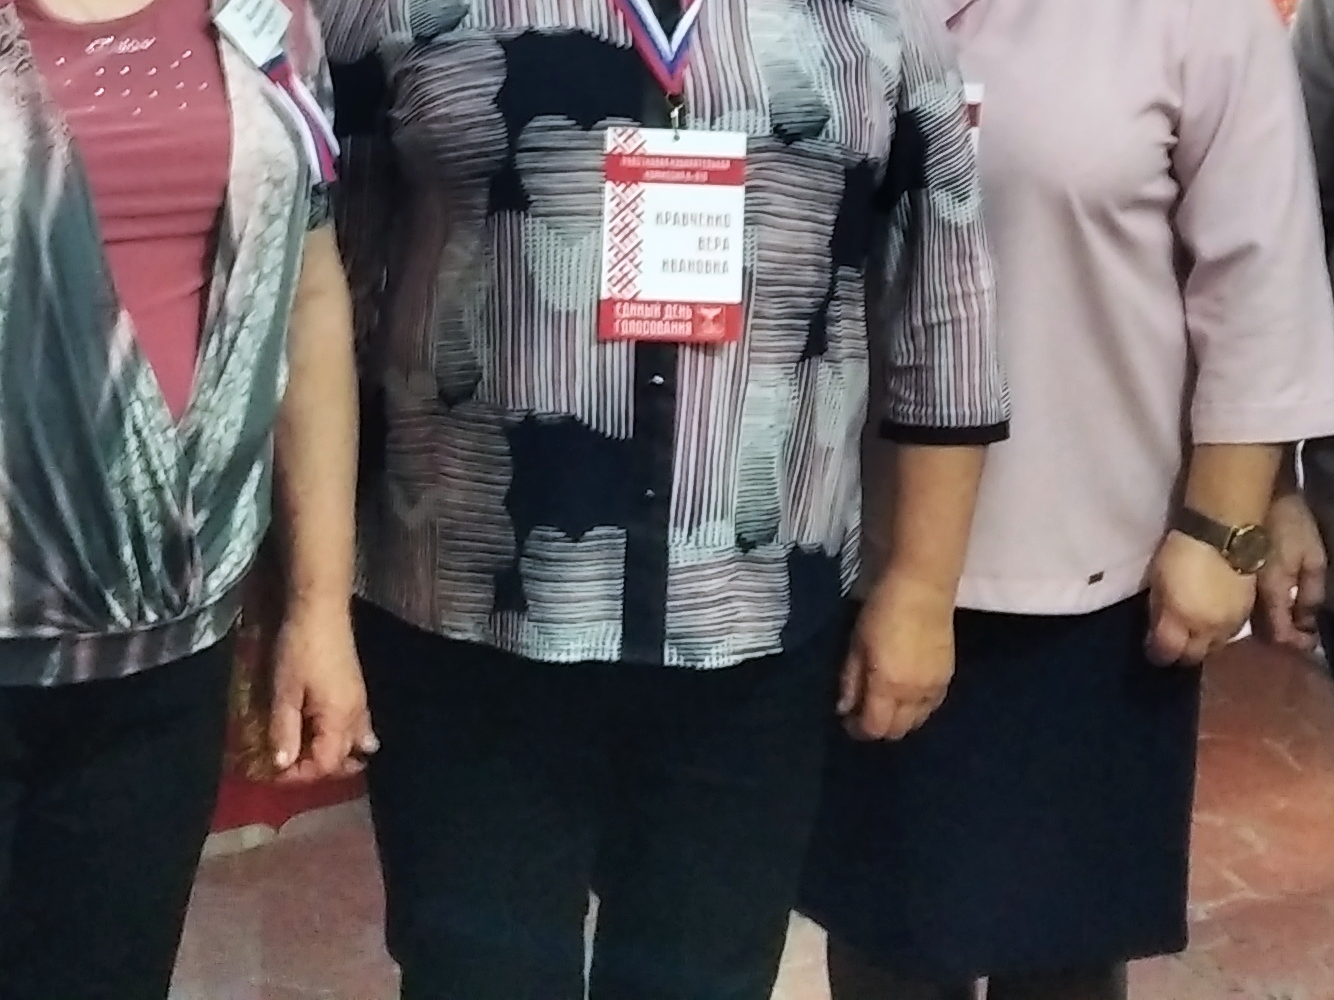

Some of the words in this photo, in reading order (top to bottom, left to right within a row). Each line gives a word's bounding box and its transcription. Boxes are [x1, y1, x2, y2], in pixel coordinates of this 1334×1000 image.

[655, 211, 731, 228] КРАВЧЕНКО
[698, 236, 730, 251] ВЕРА
[662, 259, 730, 275] ИВАНОВНА
[615, 301, 661, 318] ЕДИНЫЙ
[663, 304, 693, 321] ДЕНЬ
[614, 320, 693, 336] ГОЛОСОВАНИЯ
